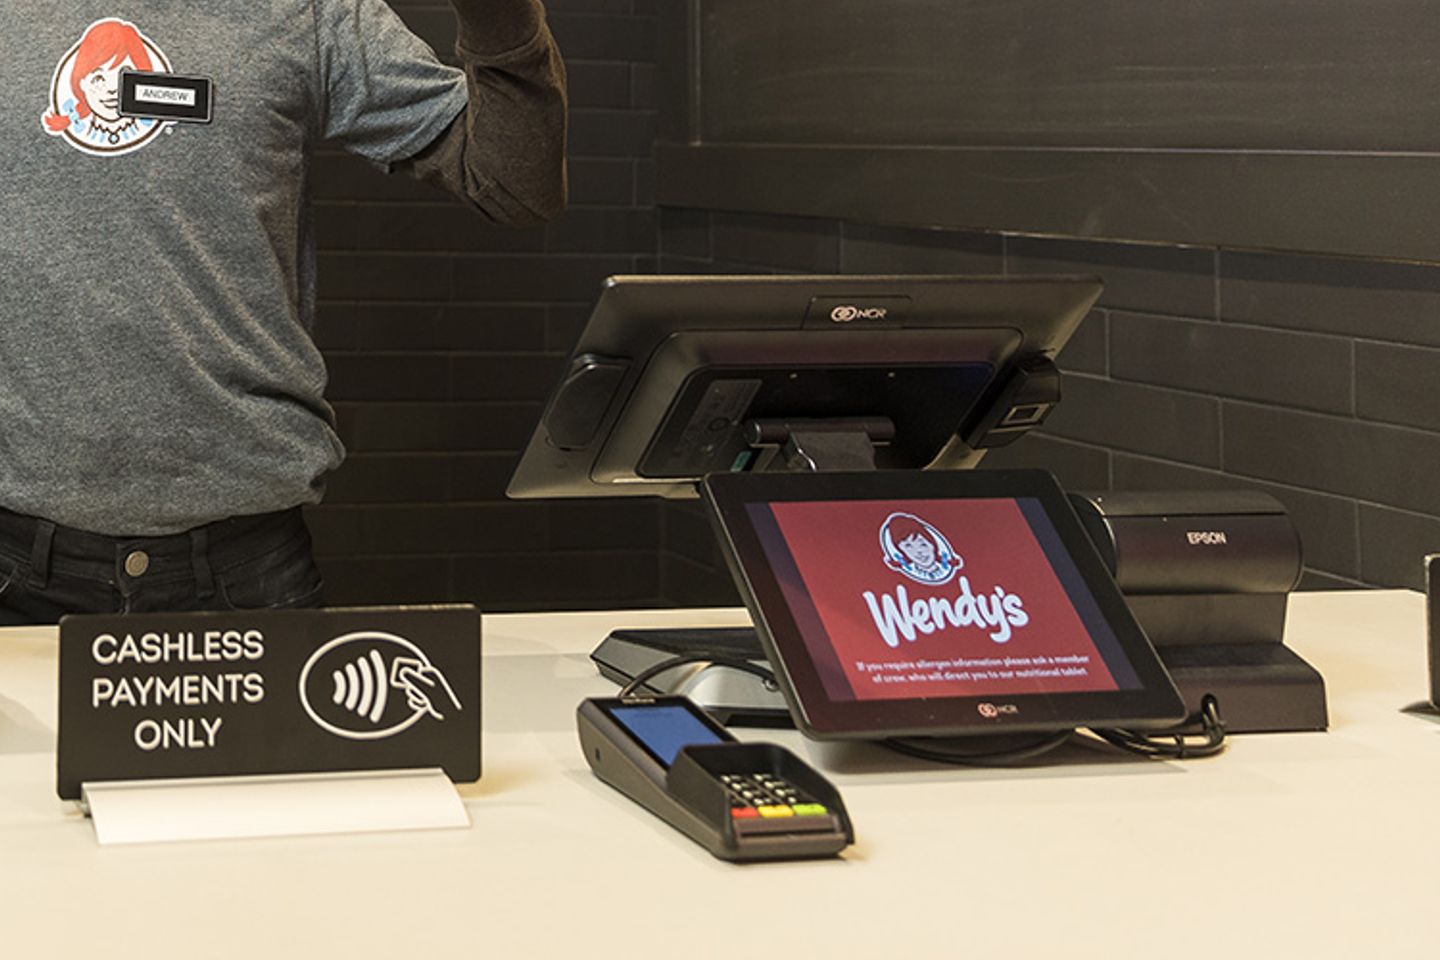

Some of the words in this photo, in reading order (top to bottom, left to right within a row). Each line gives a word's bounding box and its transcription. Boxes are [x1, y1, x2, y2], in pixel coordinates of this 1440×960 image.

[143, 89, 189, 102] ANDREW
[857, 308, 887, 319] NCR
[1187, 531, 1227, 545] EPSON
[862, 576, 1029, 648] Wendy's
[91, 630, 265, 665] CASHLESS
[866, 663, 882, 672] you
[952, 658, 1003, 667] information
[1003, 656, 1030, 667] please
[1032, 656, 1046, 664] ask
[1054, 654, 1089, 663] member
[944, 672, 970, 680] direct
[971, 672, 987, 682] you
[1016, 668, 1060, 678] nutritional
[92, 673, 265, 708] PAYMENTS
[997, 704, 1019, 713] NCR
[134, 717, 223, 751] ONLY
